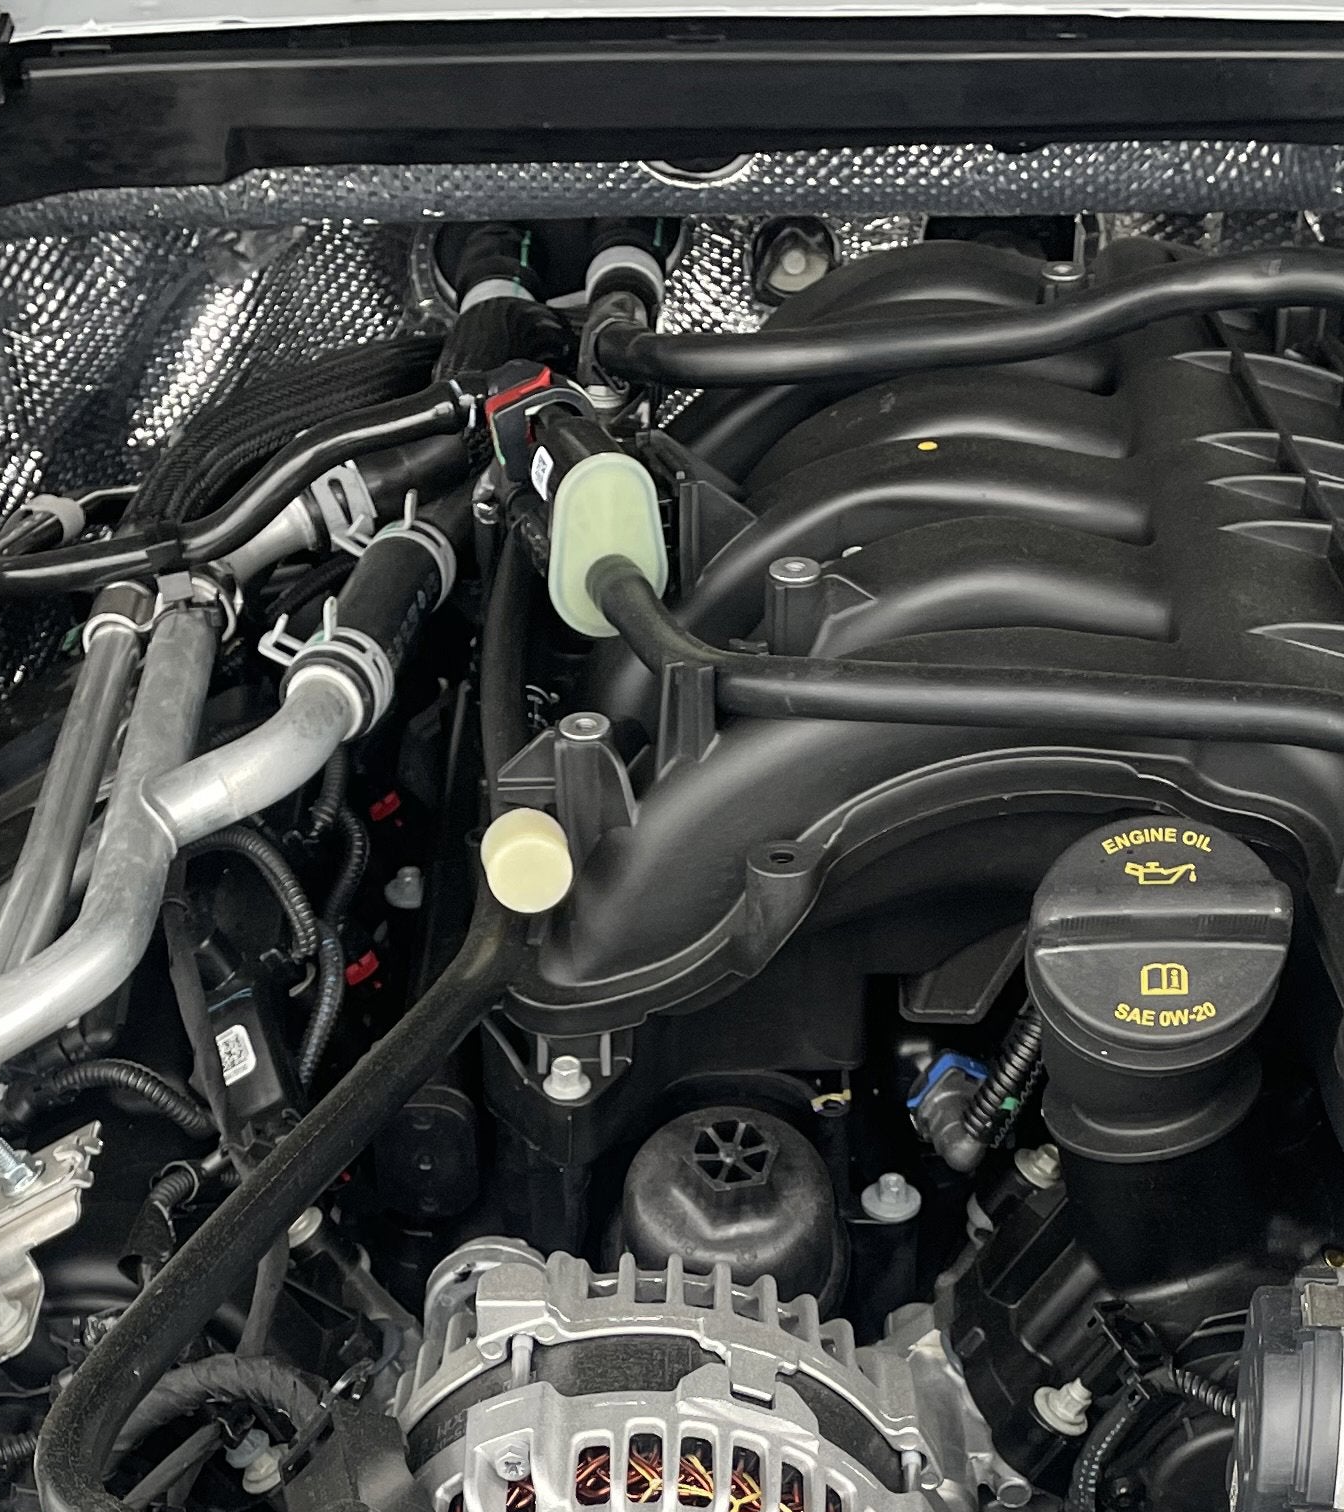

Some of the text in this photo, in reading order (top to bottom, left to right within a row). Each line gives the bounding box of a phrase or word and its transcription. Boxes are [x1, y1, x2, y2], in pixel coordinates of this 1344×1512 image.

[1102, 828, 1213, 854] ENGINE OIL
[1114, 1001, 1216, 1027] SAE 0W-20
